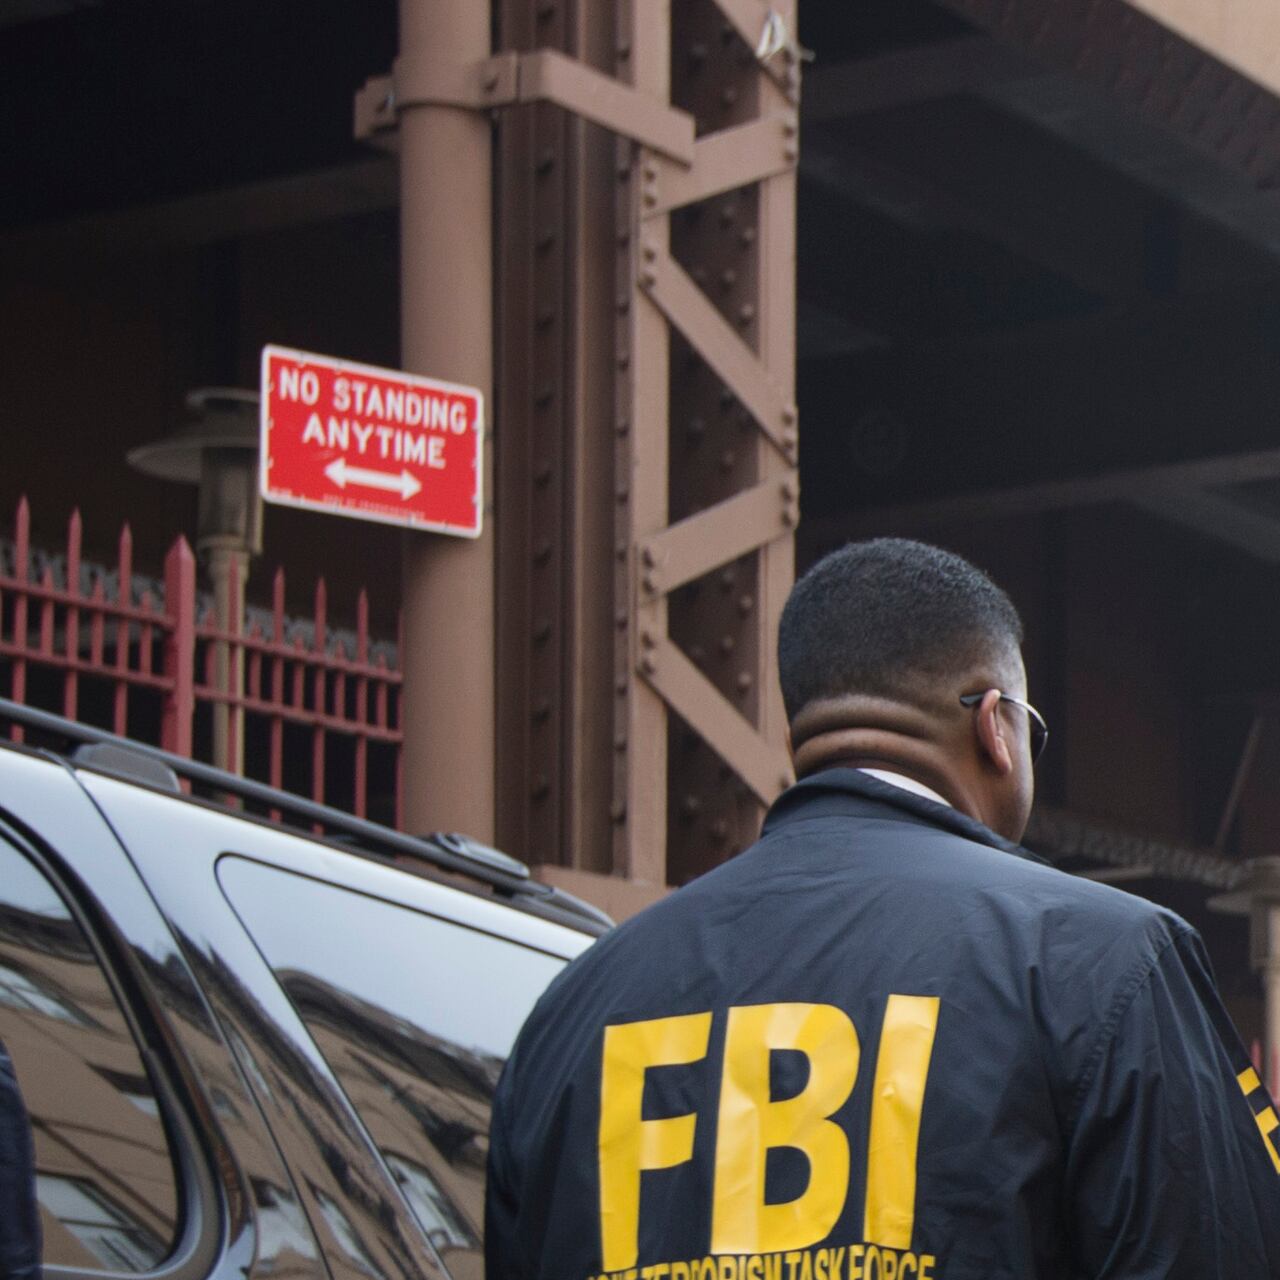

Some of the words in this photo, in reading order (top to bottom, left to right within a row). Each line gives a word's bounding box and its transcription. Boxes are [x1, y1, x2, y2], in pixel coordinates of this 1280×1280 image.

[279, 366, 320, 406] NO
[332, 377, 468, 436] STANDING
[302, 412, 447, 470] ANYTIME
[599, 993, 941, 1273] FBI
